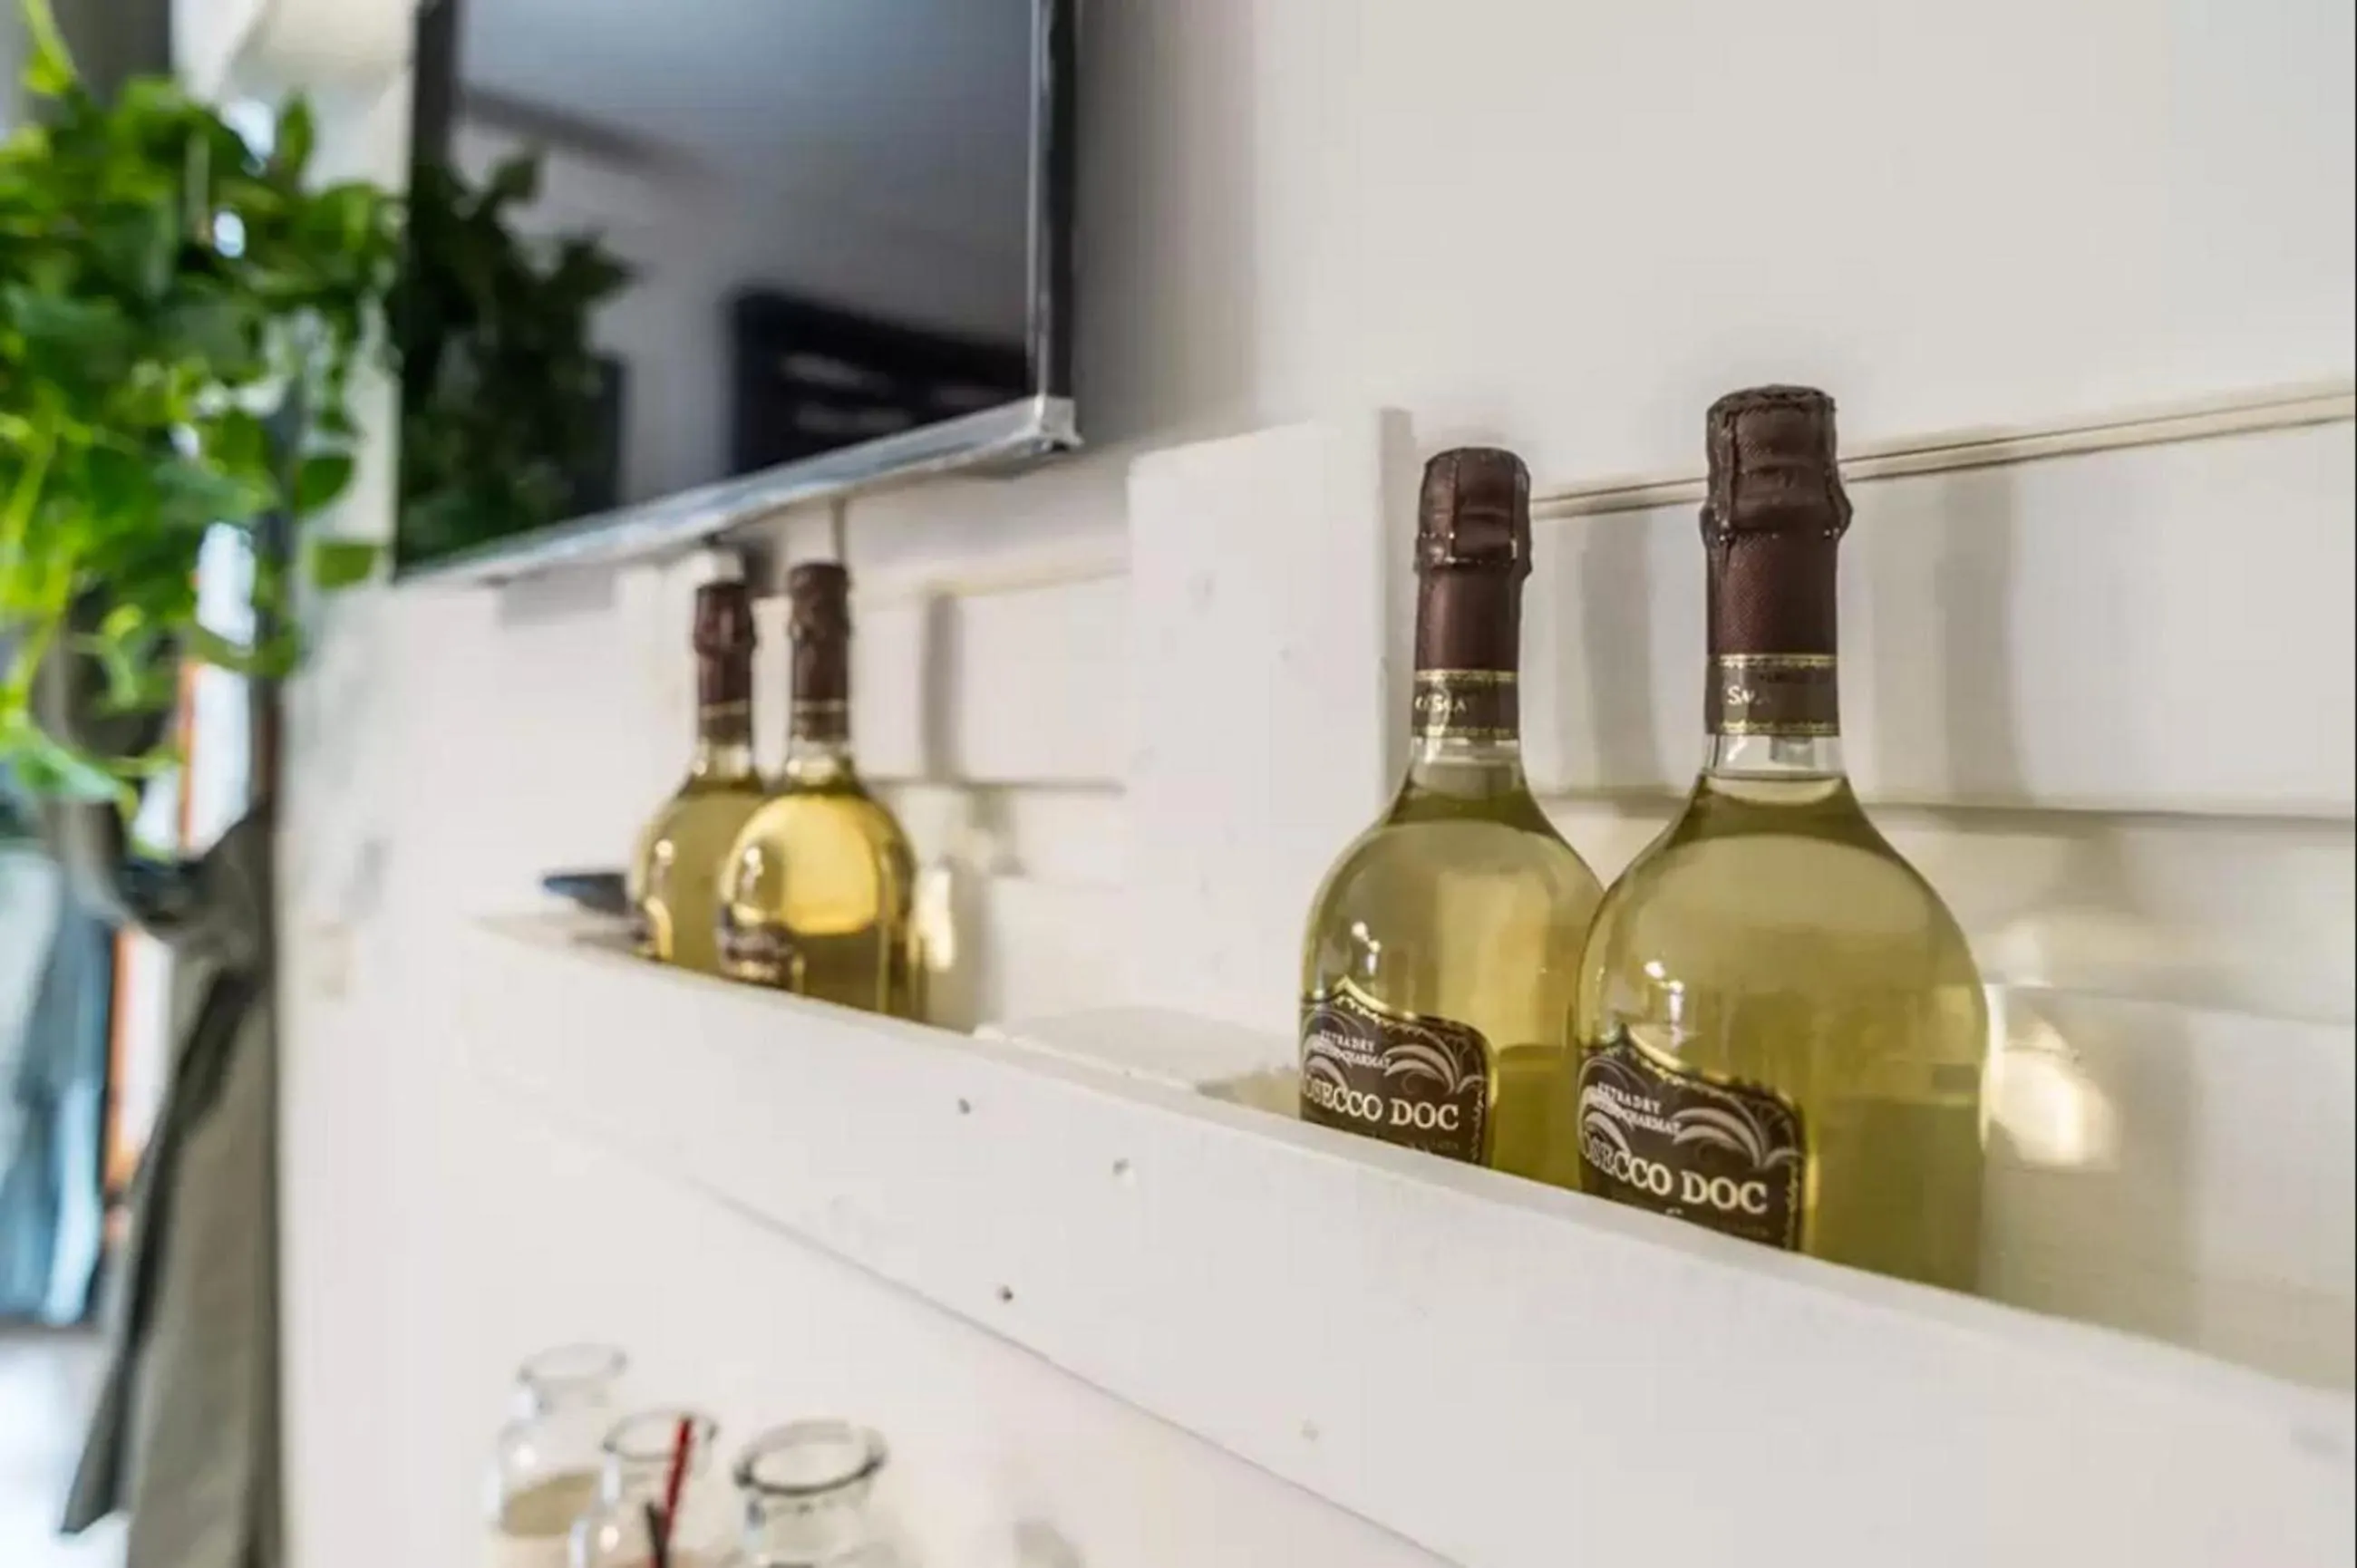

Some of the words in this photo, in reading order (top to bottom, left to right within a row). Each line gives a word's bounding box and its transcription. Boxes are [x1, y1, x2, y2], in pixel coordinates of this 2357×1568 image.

[1390, 1098, 1460, 1131] DOC
[1632, 1094, 1661, 1116] DRY
[1680, 1169, 1768, 1215] DOC
